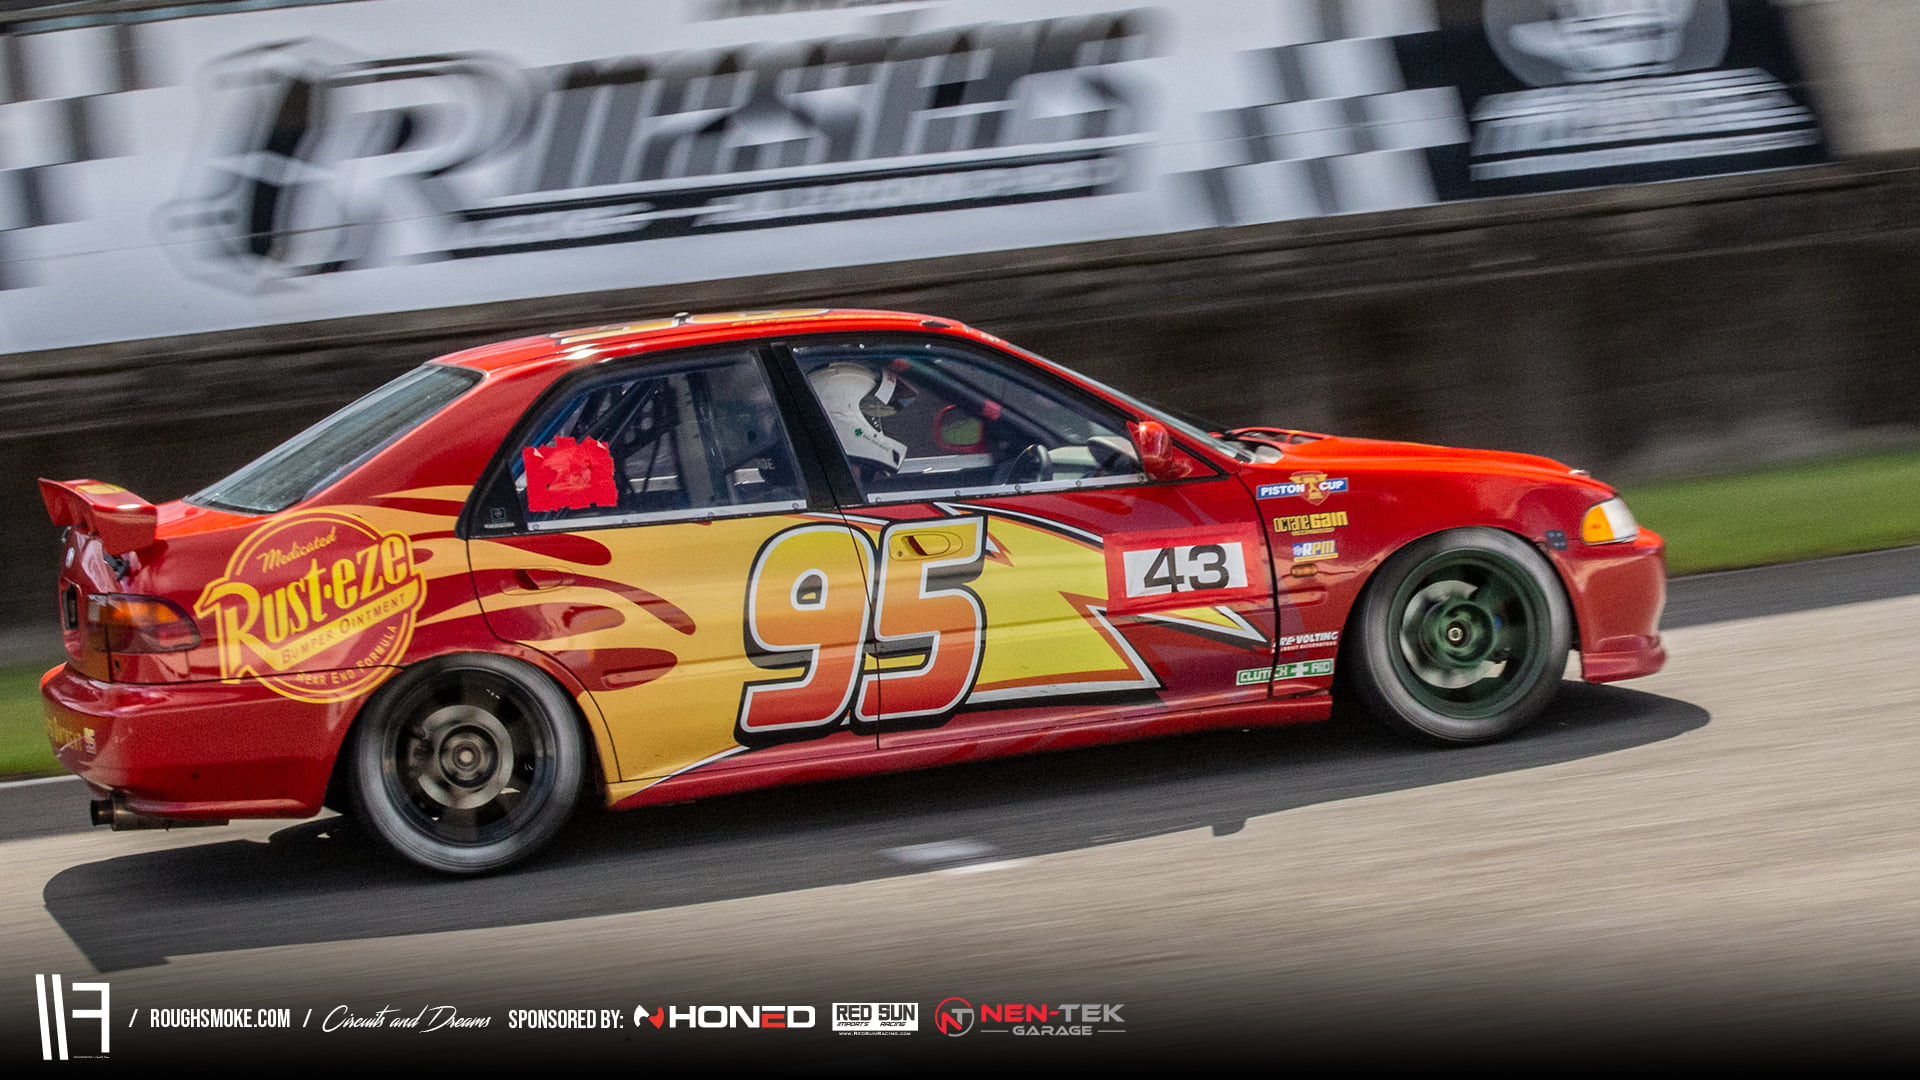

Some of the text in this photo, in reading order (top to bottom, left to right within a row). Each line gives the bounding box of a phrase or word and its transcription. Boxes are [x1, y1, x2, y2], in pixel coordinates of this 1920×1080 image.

[1260, 480, 1345, 497] PISTON CUP
[256, 525, 337, 574] Medicated
[1143, 543, 1230, 593] 43
[281, 592, 408, 665] BUMPER OINTMENT
[736, 513, 988, 744] 95
[331, 669, 356, 685] END
[355, 625, 398, 673] FORMULA
[1240, 661, 1331, 682] CLUTCH AID
